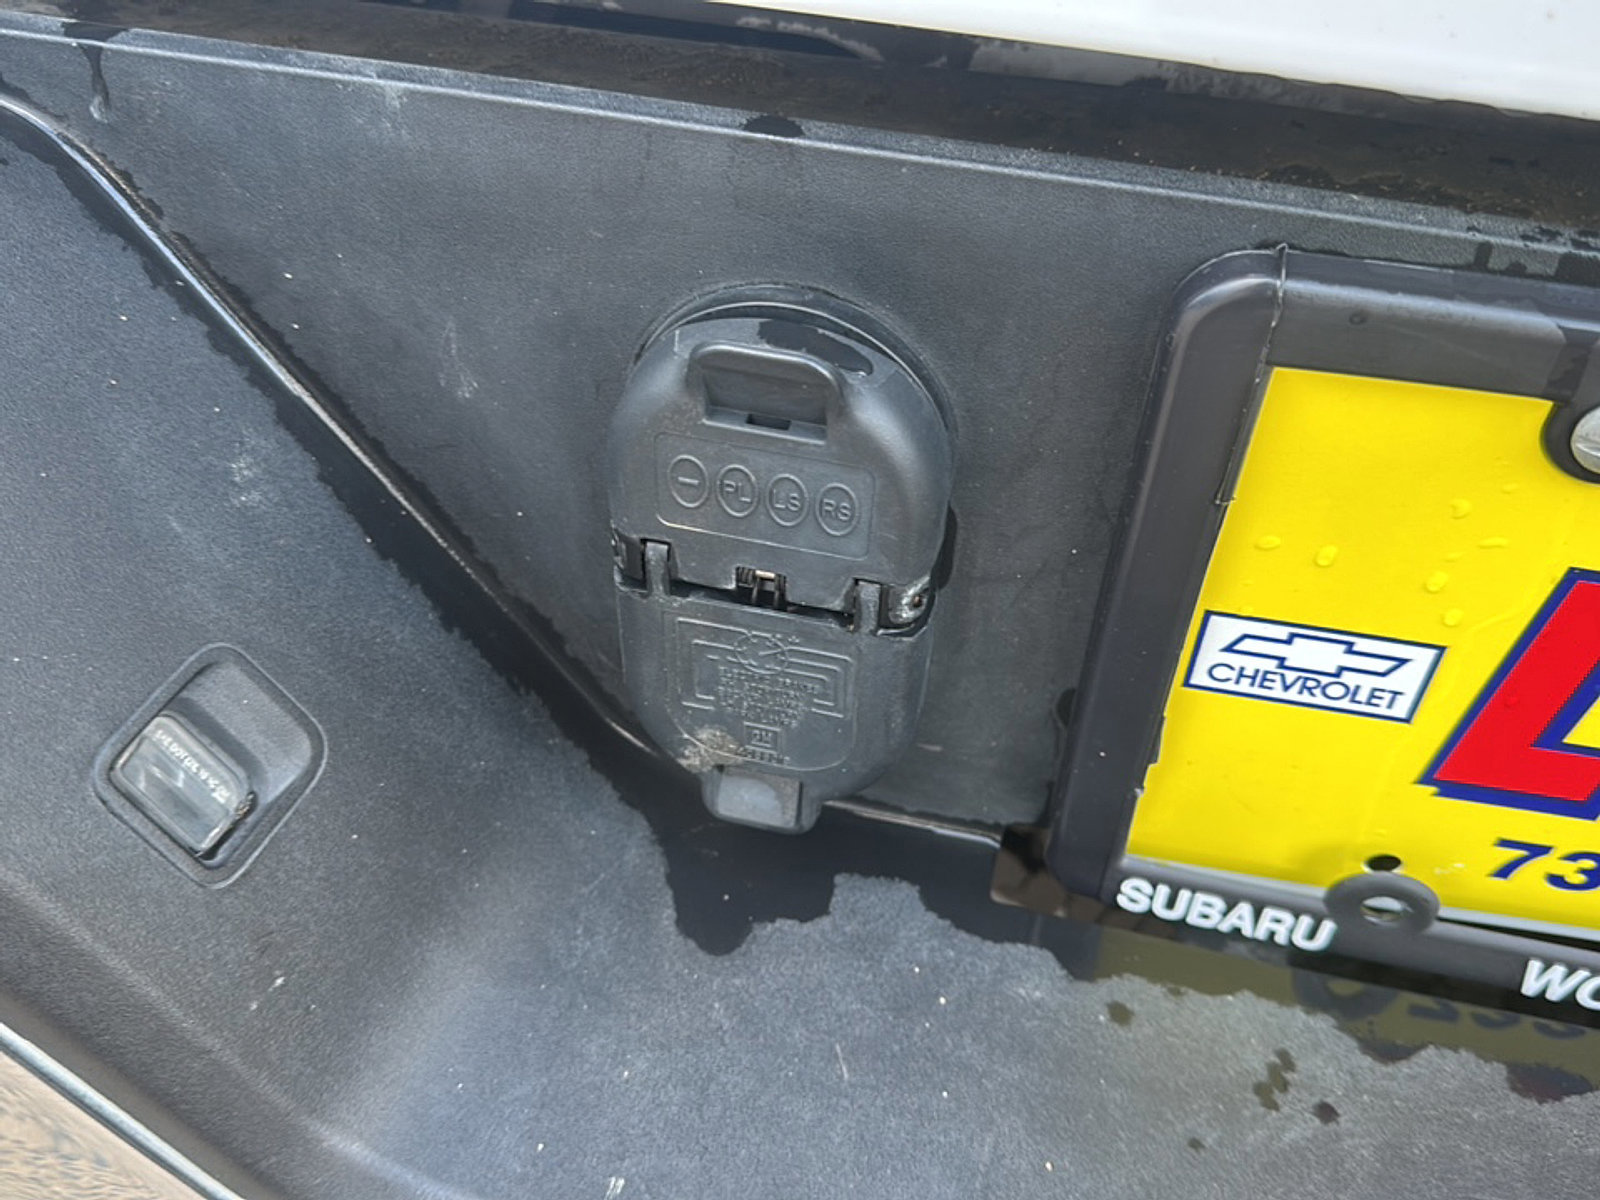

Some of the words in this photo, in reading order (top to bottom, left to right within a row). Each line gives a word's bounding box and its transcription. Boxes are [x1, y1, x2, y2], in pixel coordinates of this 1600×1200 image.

[721, 479, 751, 503] PL
[772, 488, 801, 512] LS
[821, 498, 851, 521] RS
[1207, 663, 1405, 710] CHEVROLET
[1116, 877, 1338, 952] SUBARU
